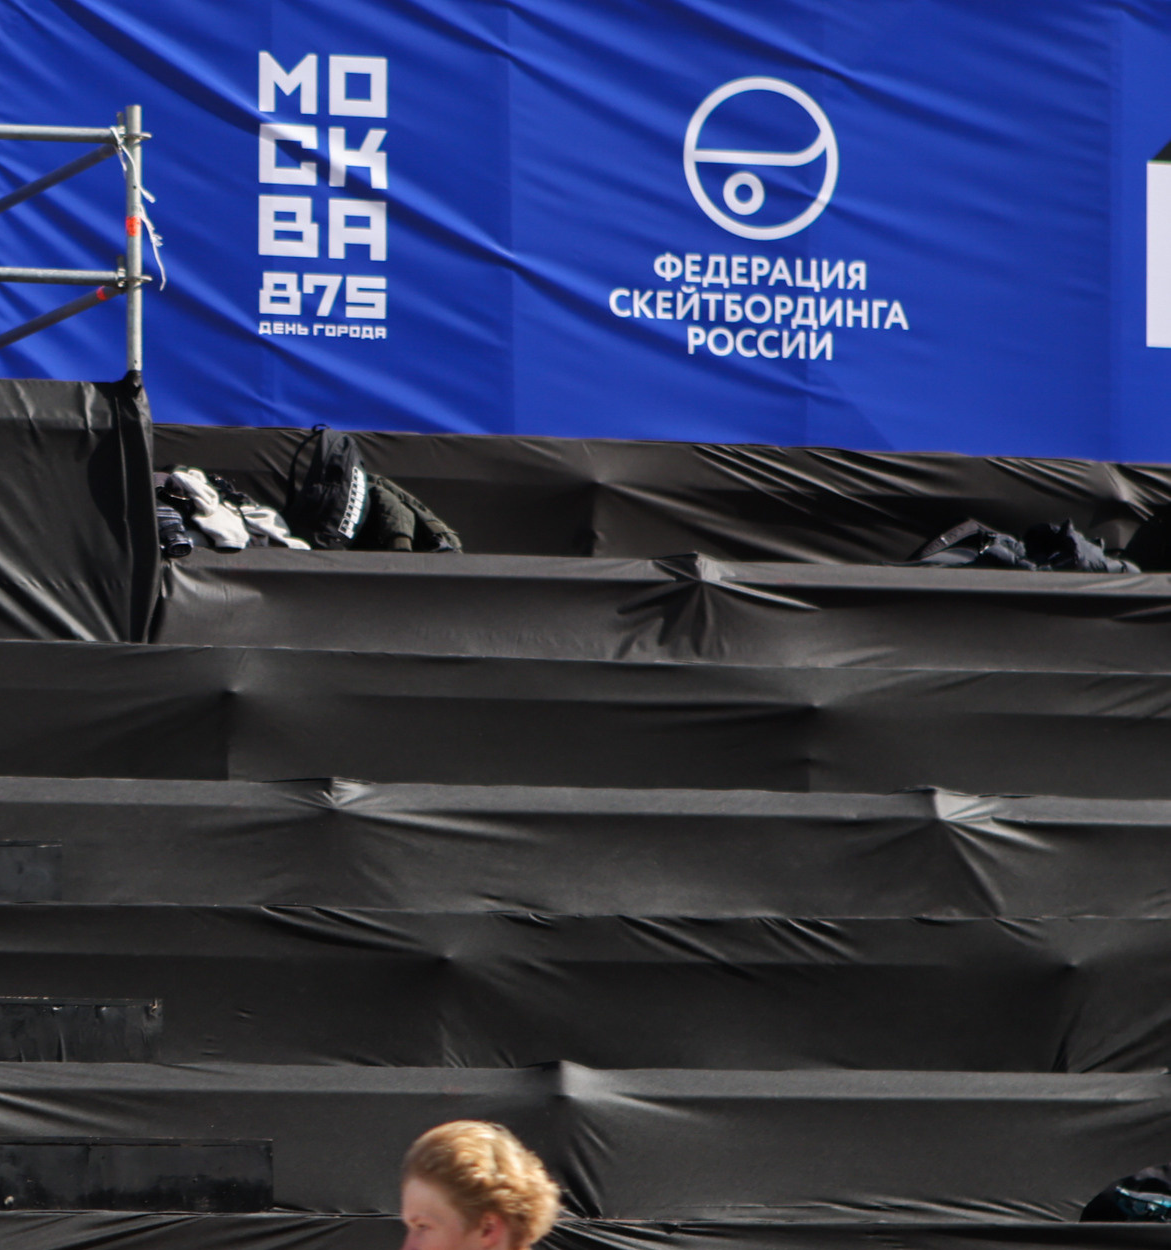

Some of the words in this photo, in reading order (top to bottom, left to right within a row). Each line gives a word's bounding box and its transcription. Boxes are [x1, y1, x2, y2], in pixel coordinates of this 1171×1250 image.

[653, 252, 867, 293] ФЕДЕРАЦИЯ
[258, 271, 387, 320] 875
[608, 285, 909, 331] СКЕЙТБОРДИНГА
[257, 321, 309, 336] ДЕНЬ
[312, 323, 387, 340] ГОРОДА
[687, 325, 833, 361] РОССИИ
